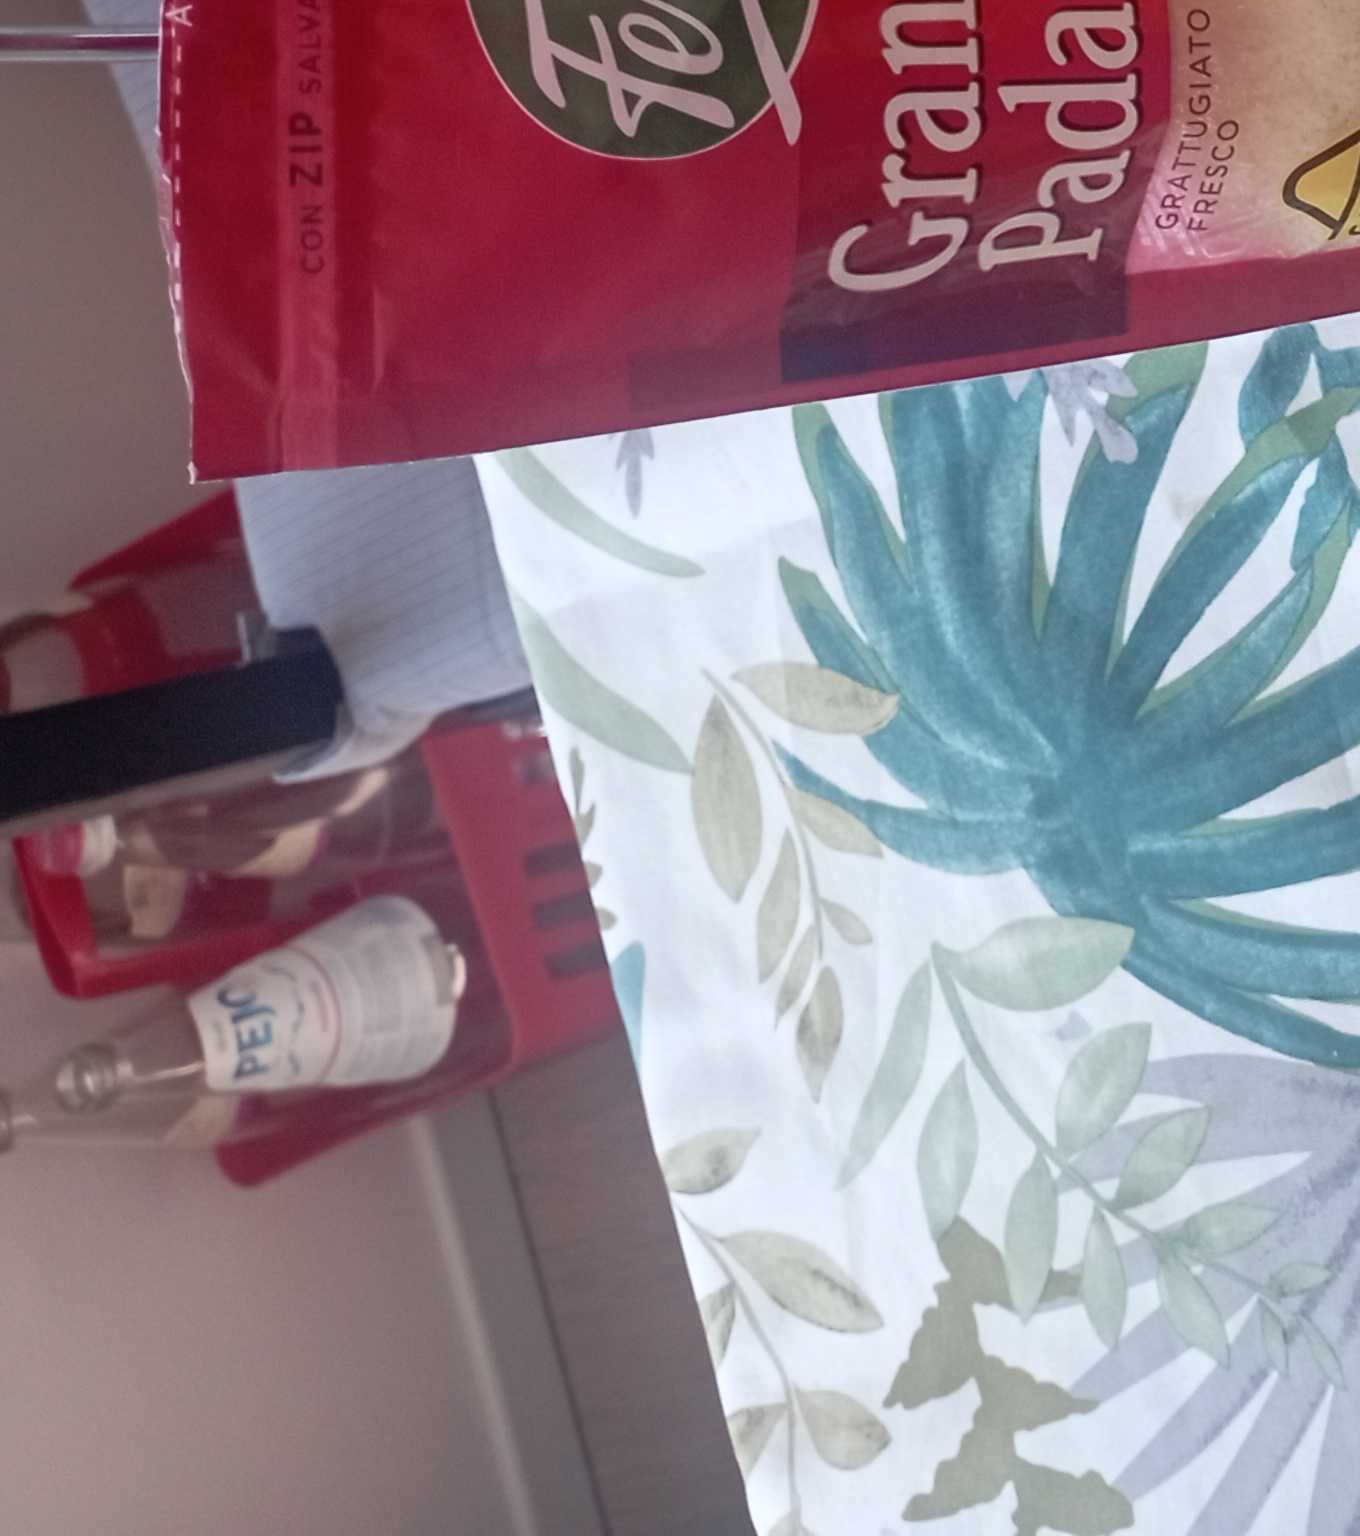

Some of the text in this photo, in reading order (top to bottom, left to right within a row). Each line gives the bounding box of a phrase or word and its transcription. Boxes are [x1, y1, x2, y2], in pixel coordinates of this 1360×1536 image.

[288, 111, 324, 186] ZIP
[1154, 6, 1213, 229] GRATTUGIATO
[1186, 118, 1241, 231] FRESCO
[299, 203, 325, 273] CON
